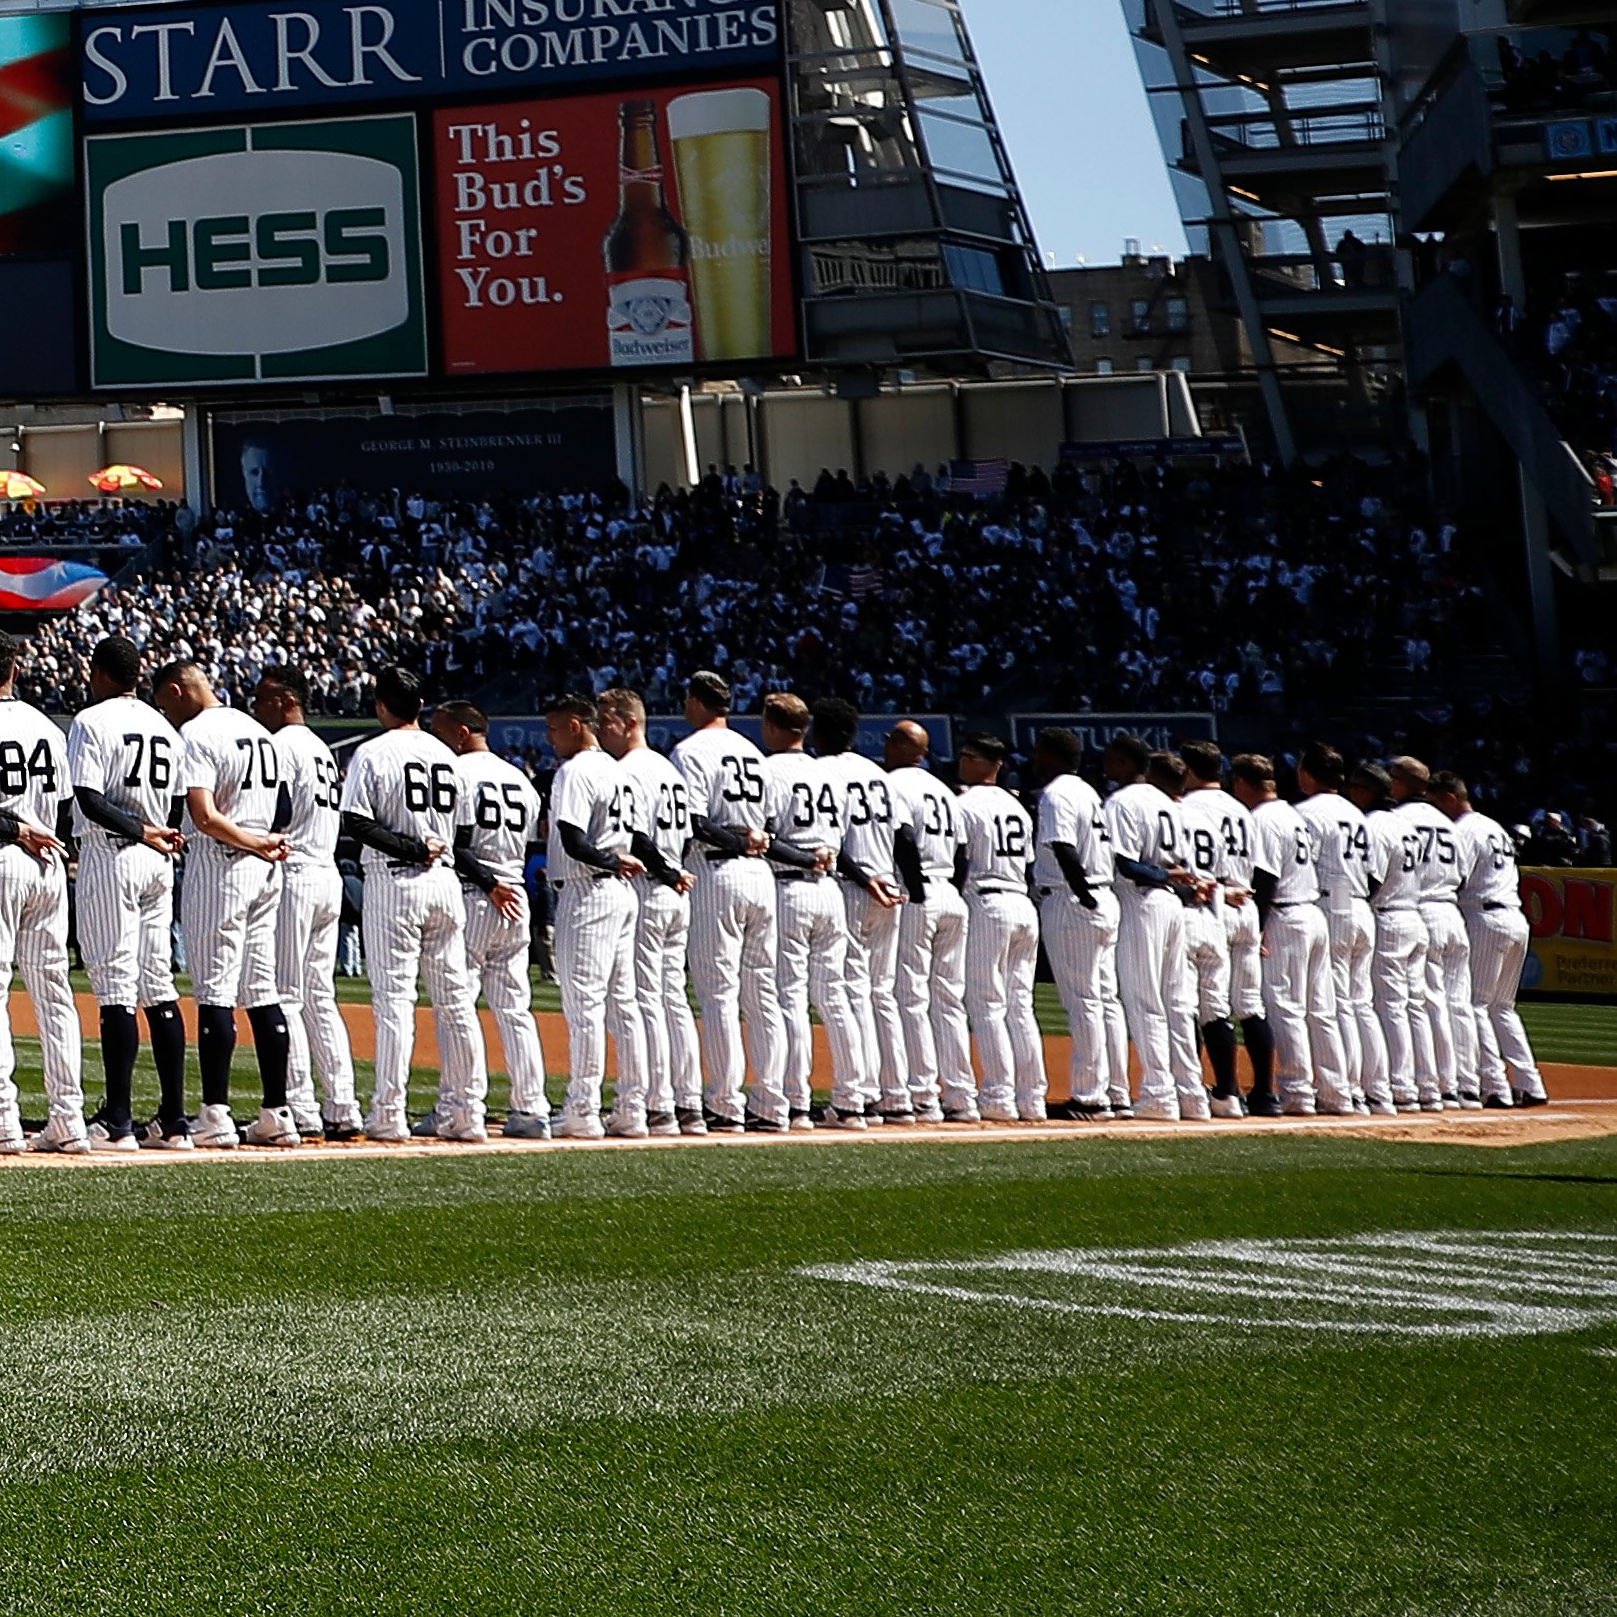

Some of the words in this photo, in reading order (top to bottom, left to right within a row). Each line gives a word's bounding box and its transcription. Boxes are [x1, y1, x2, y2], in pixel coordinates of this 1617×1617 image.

[82, 4, 422, 107] STARR
[463, 4, 778, 79] COMPANIES
[447, 122, 562, 167] This
[453, 166, 587, 214] Bud's
[119, 205, 389, 297] HESS
[456, 217, 538, 260] For
[455, 265, 564, 309] You.
[361, 439, 415, 452] GEORGE
[439, 435, 543, 449] STEINBRENNER
[123, 733, 171, 789] 76
[236, 737, 278, 790] 70
[722, 756, 763, 803] 35
[404, 762, 456, 813] 66
[477, 781, 525, 832] 65
[609, 784, 635, 832] 43
[657, 783, 686, 829] 36
[793, 783, 838, 828] 34
[847, 780, 891, 825] 33
[924, 793, 954, 836] 31
[994, 815, 1025, 856] 12
[1221, 816, 1248, 857] 41
[1416, 825, 1455, 863] 75
